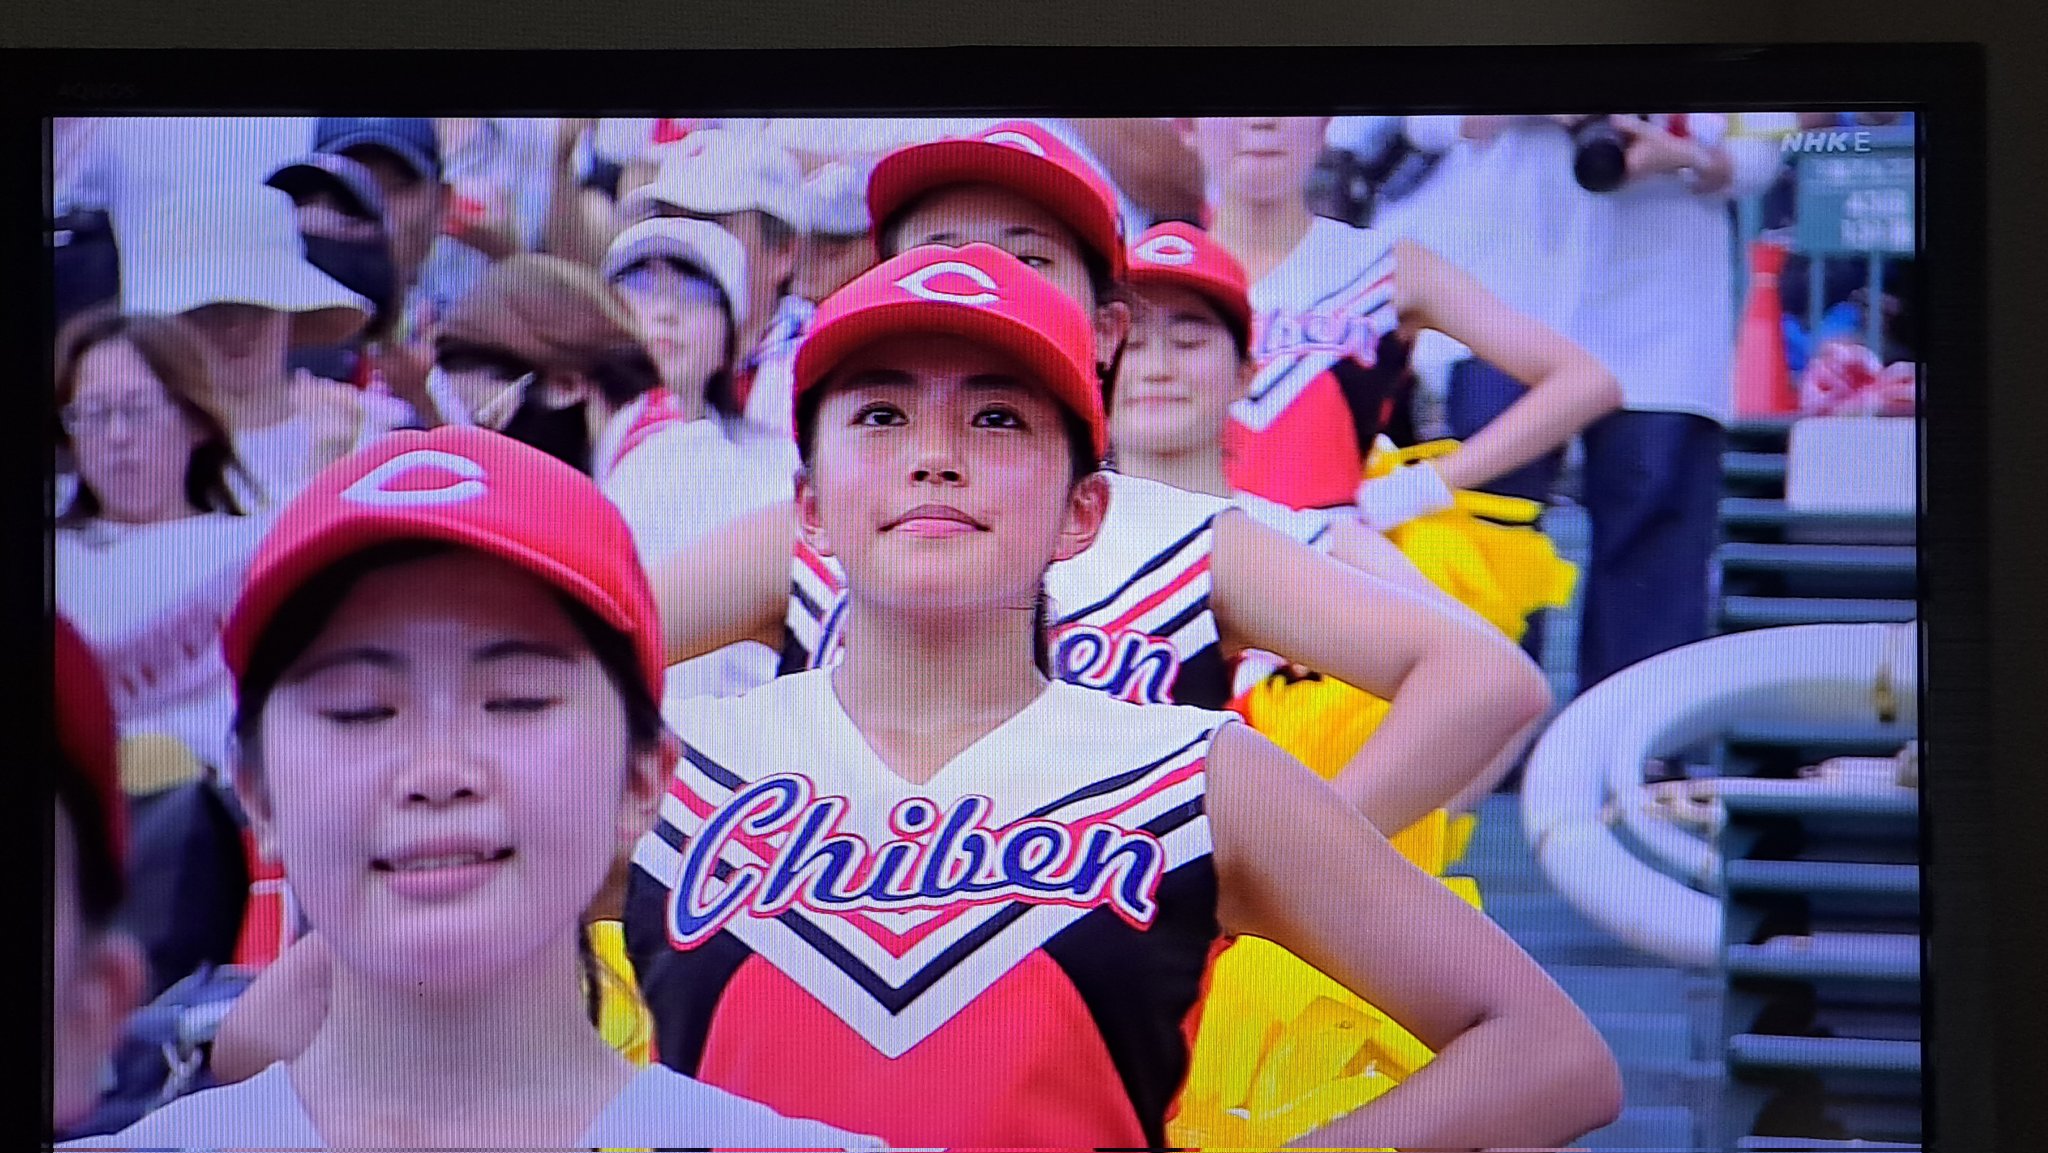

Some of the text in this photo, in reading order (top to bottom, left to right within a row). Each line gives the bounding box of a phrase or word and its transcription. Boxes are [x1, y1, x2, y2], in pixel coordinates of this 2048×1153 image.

[1780, 131, 1872, 152] NHK E
[666, 771, 1164, 952] Chiben
